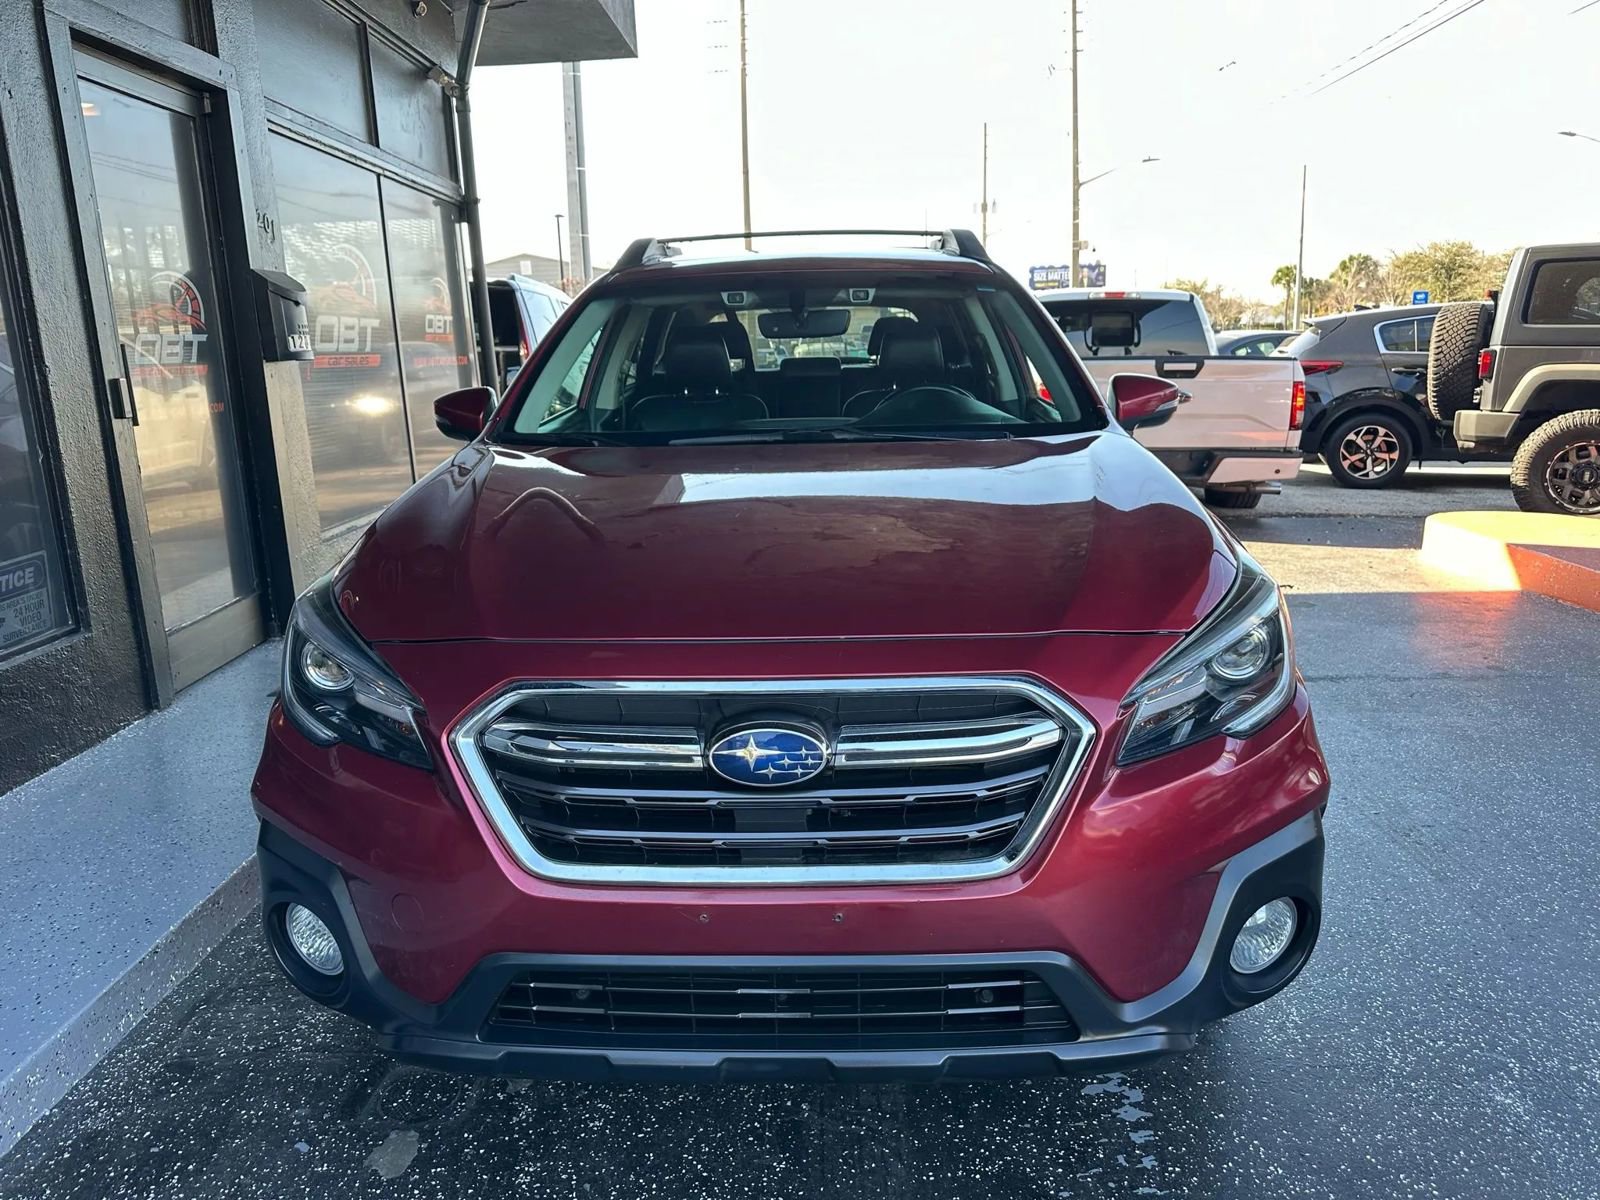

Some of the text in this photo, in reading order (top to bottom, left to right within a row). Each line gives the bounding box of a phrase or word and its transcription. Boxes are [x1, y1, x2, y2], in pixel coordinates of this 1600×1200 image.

[425, 314, 453, 333] OBT
[315, 315, 380, 352] OBT
[135, 333, 208, 364] OBT
[24, 599, 45, 613] HOUR
[20, 611, 42, 626] VIDEO
